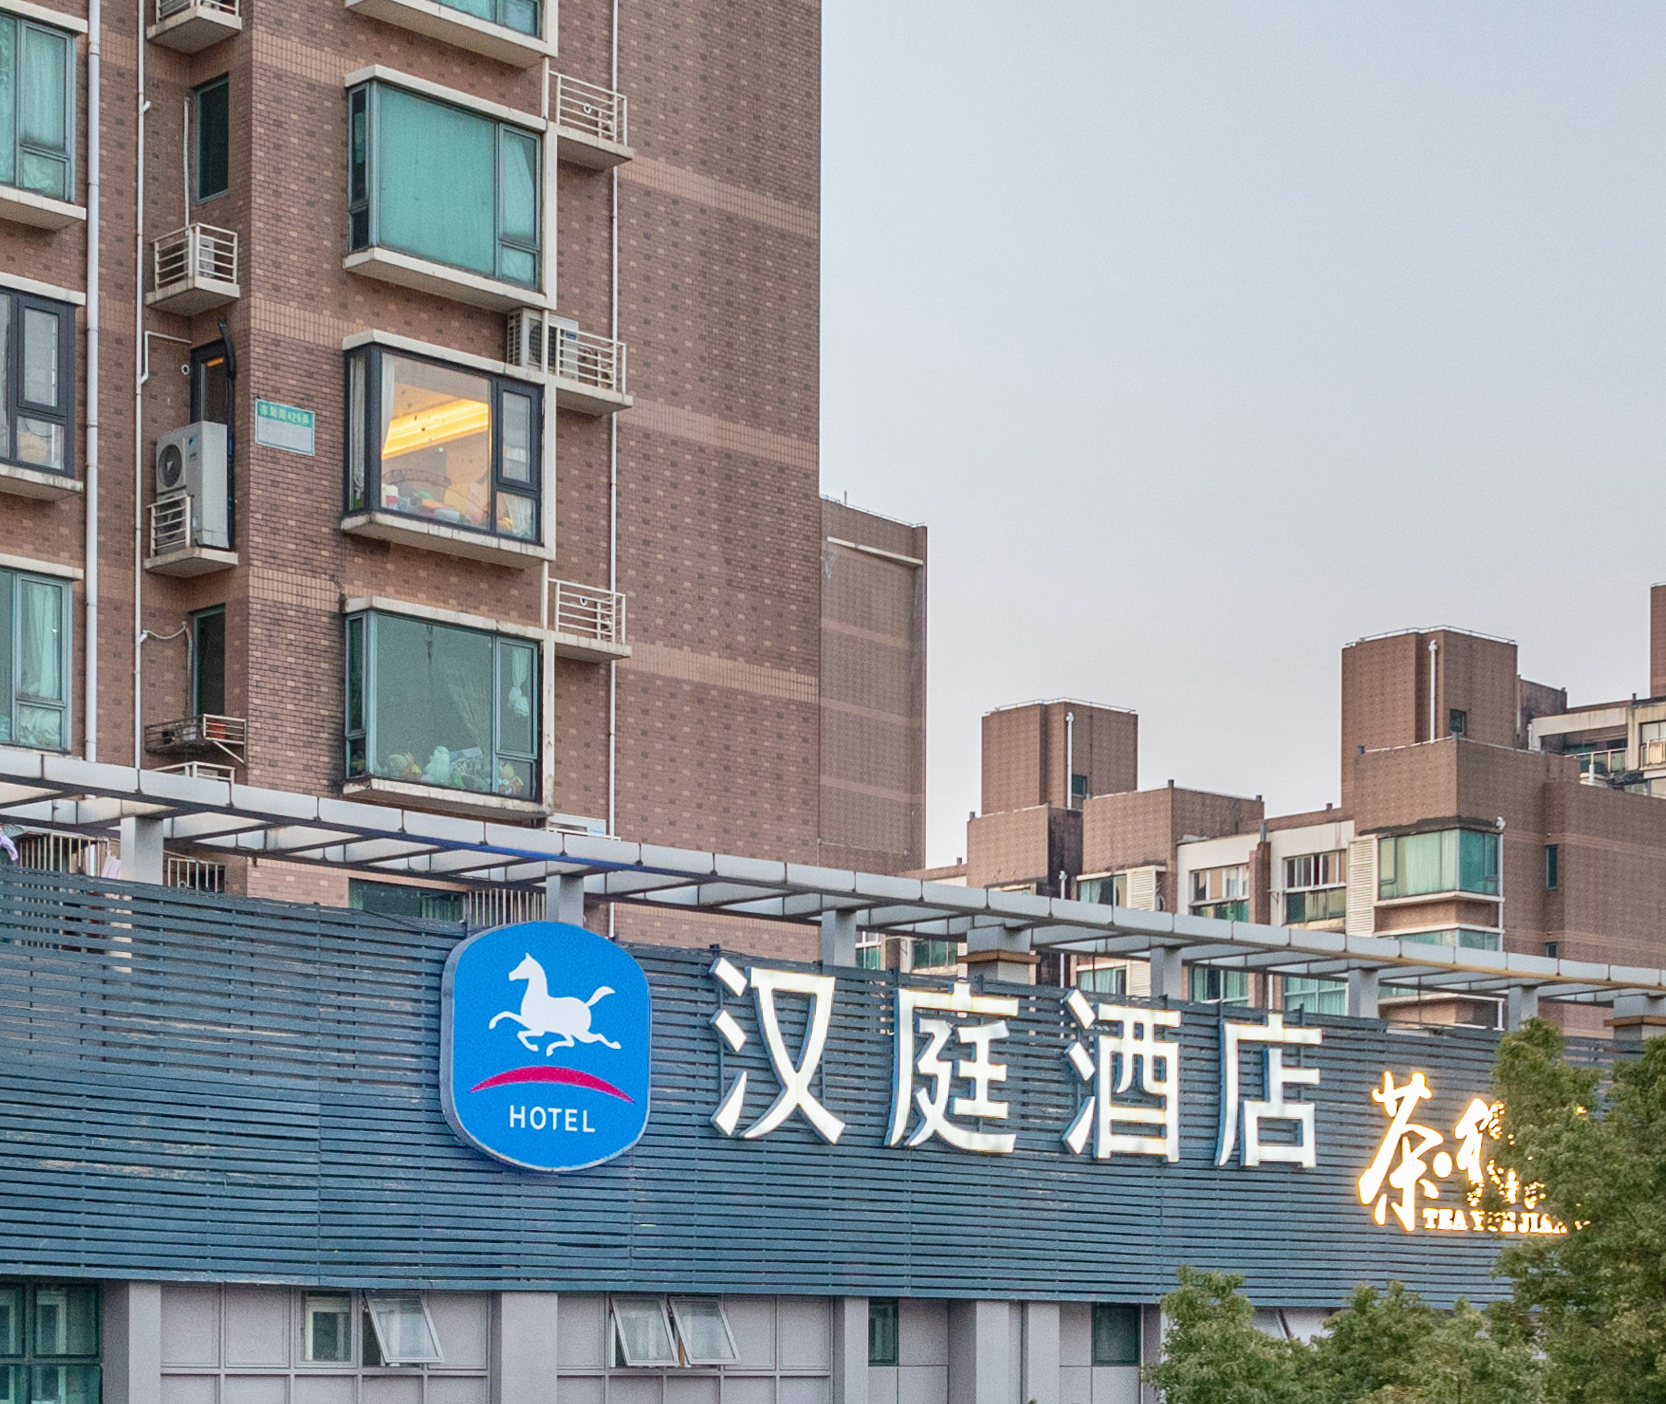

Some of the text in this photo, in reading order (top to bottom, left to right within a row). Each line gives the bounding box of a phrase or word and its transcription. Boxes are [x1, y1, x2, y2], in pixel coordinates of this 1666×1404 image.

[709, 957, 1323, 1168] 汉庭酒店
[510, 1105, 595, 1133] HOTEL
[1422, 1207, 1468, 1231] TEA
